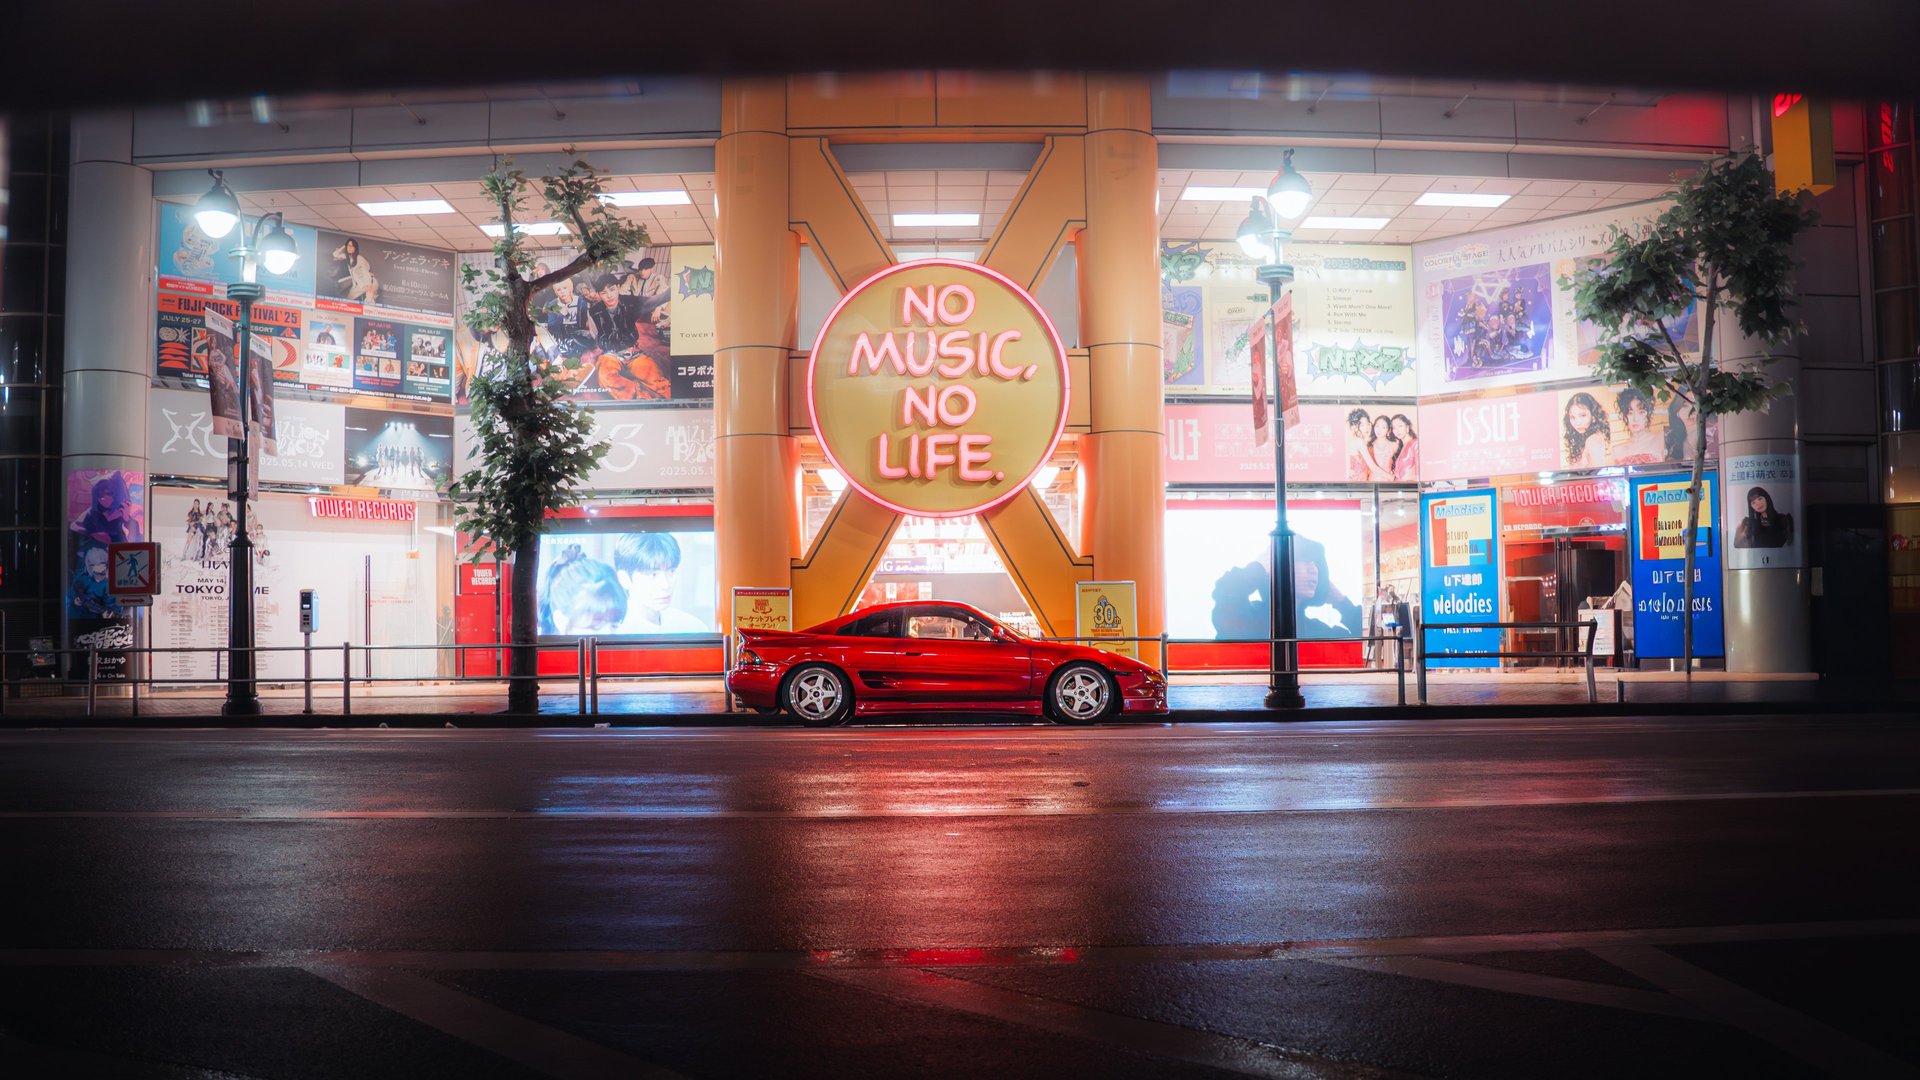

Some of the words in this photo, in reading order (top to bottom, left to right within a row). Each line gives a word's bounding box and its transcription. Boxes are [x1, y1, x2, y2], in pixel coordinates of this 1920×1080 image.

[382, 250, 450, 270] アンジェラ・アキ
[178, 298, 202, 312] FUJI
[235, 305, 279, 322] FTIVAL
[902, 284, 976, 326] NO
[181, 317, 202, 325] 25-27
[848, 329, 1038, 381] MUSIC,
[1318, 346, 1405, 375] NEXZ
[903, 384, 977, 427] NO
[260, 457, 308, 468] 025.05.14
[878, 432, 1005, 481] LIFE.
[660, 466, 713, 476] 2025.05.1
[1511, 487, 1556, 506] TOWER
[308, 497, 353, 518] TOWER
[358, 501, 415, 521] RECORDS
[471, 577, 497, 586] RECORDS
[473, 568, 493, 578] TOWER
[176, 584, 225, 594] TOKYO
[737, 615, 788, 623] マーケットプレイス
[1093, 603, 1122, 625] 30th
